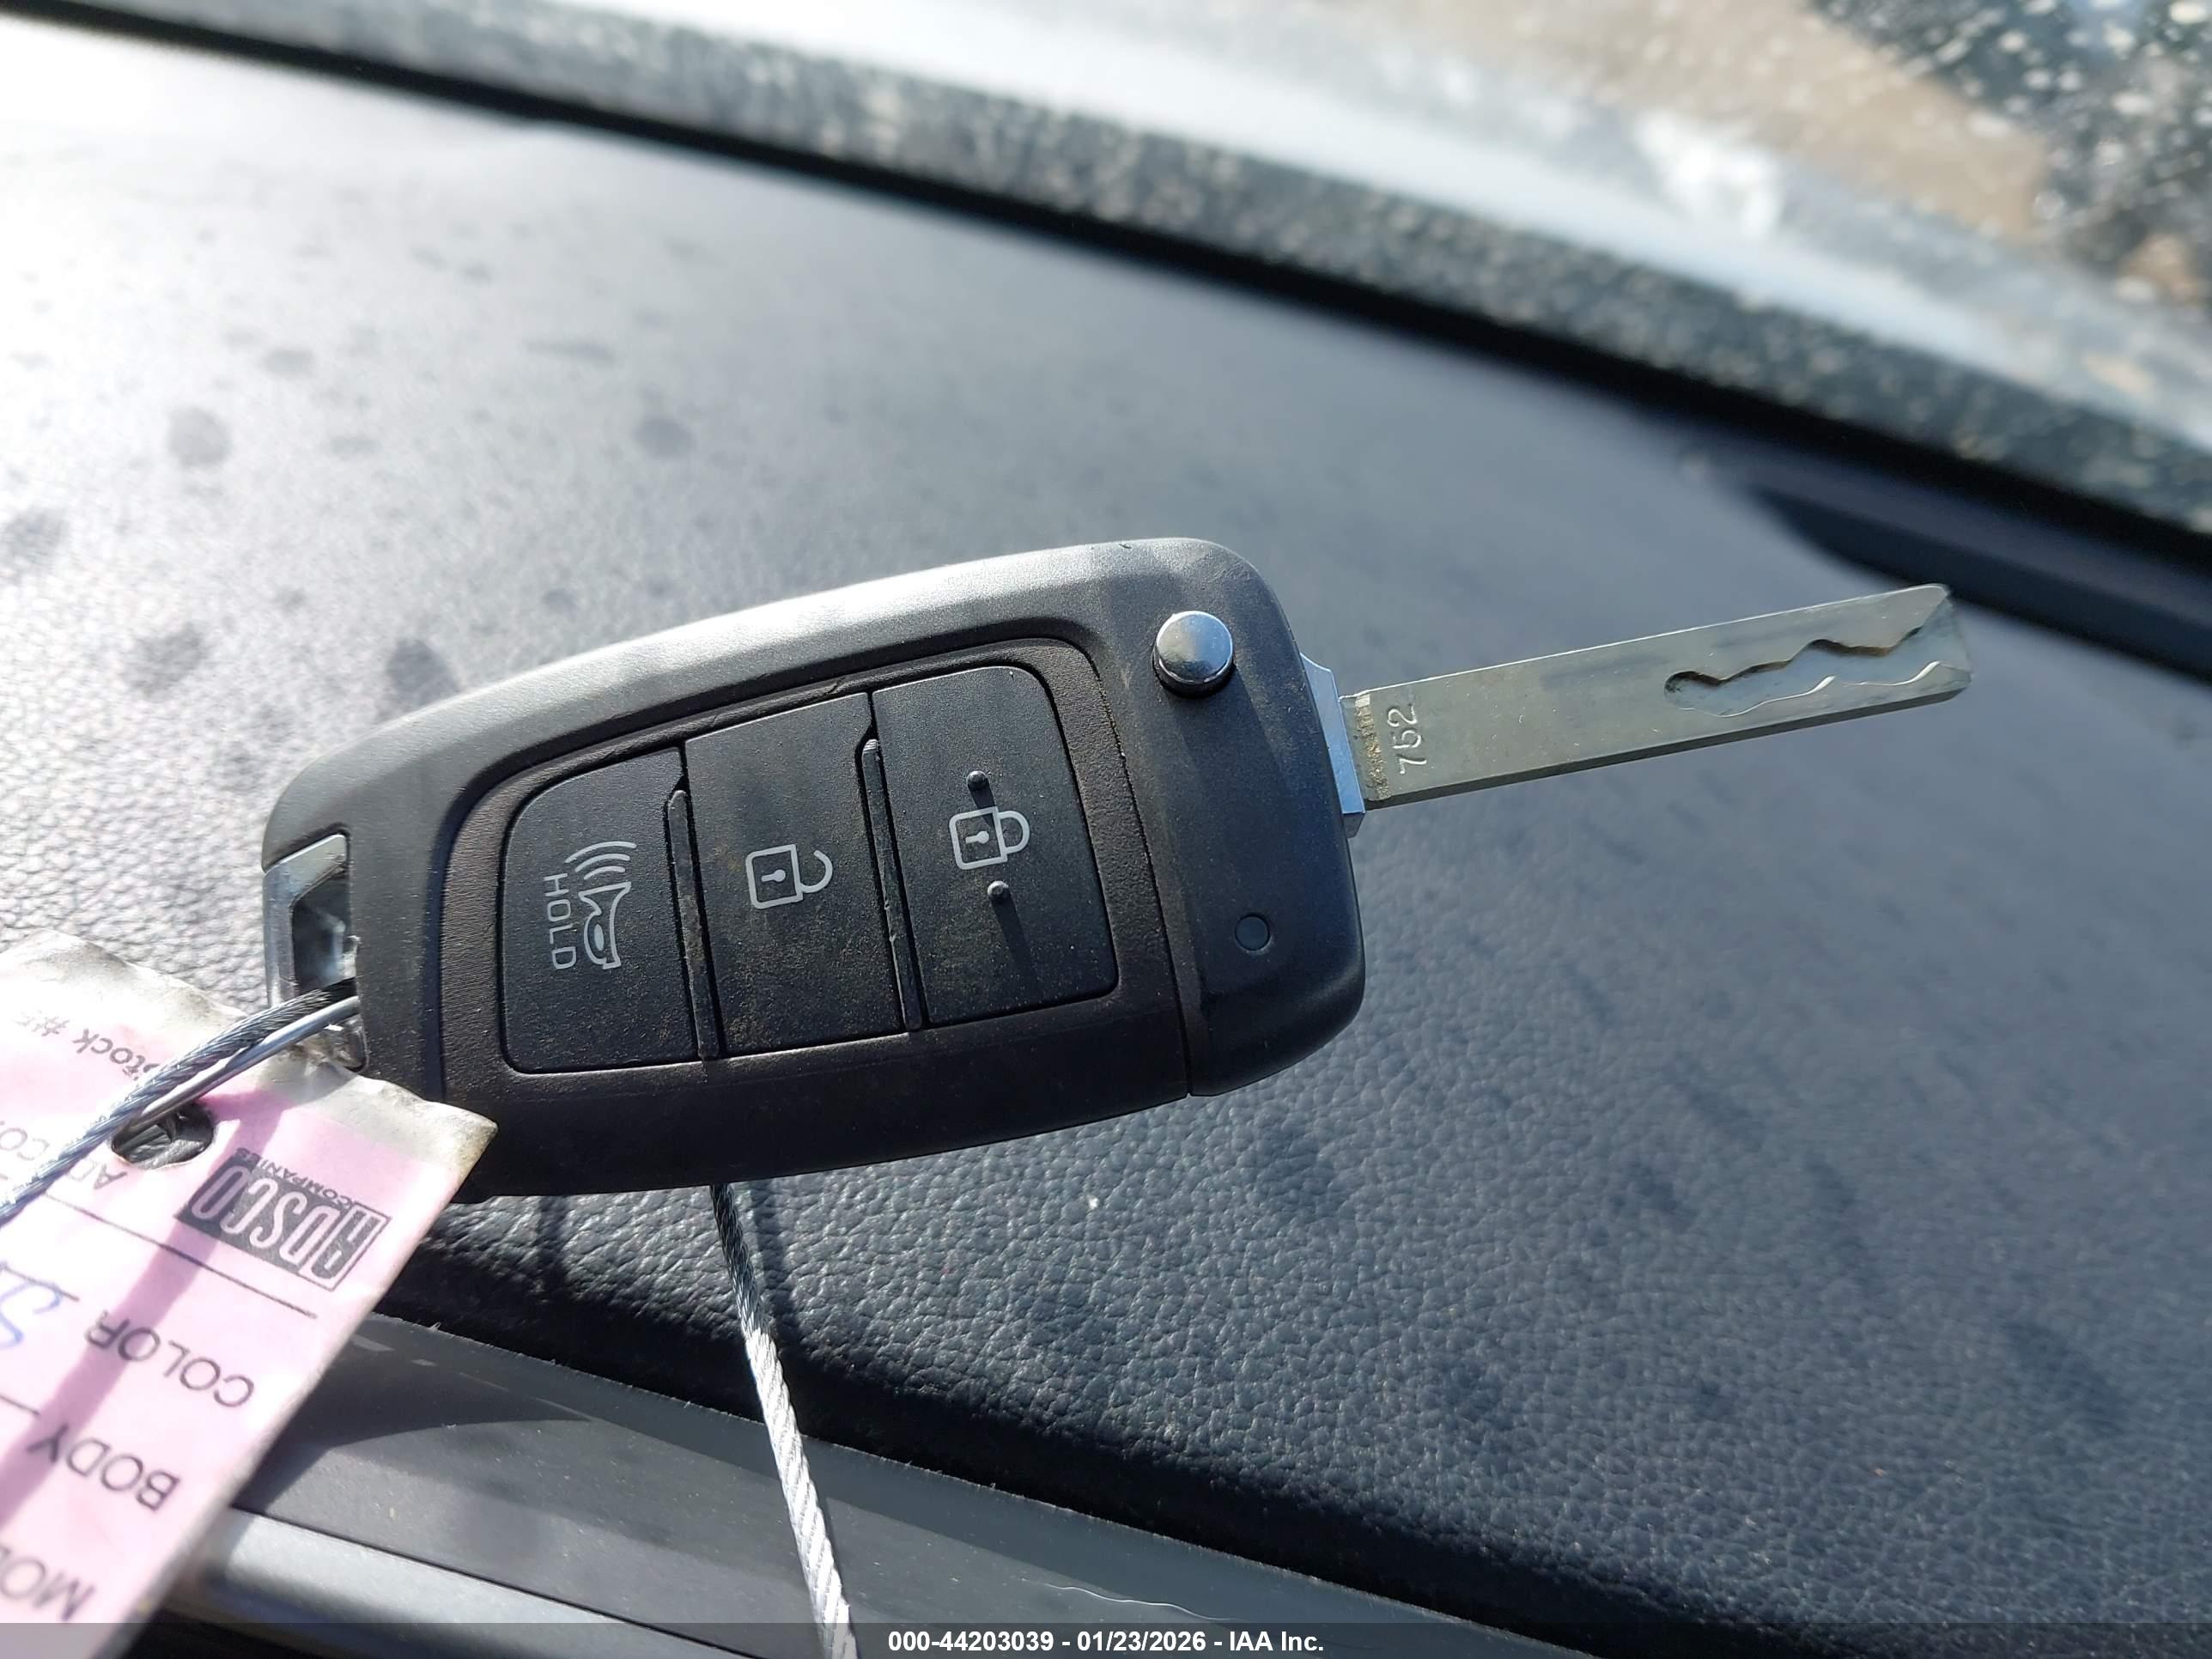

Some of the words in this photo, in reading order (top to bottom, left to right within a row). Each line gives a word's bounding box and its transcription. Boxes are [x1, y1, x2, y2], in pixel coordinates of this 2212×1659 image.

[1388, 704, 1427, 775] 752
[543, 872, 577, 969] HOLD
[235, 1146, 354, 1210] COMPANIES
[190, 1165, 388, 1290] ADSCO
[84, 1310, 255, 1408] COLOR
[26, 1422, 181, 1512] BODY
[0, 1548, 96, 1623] MO
